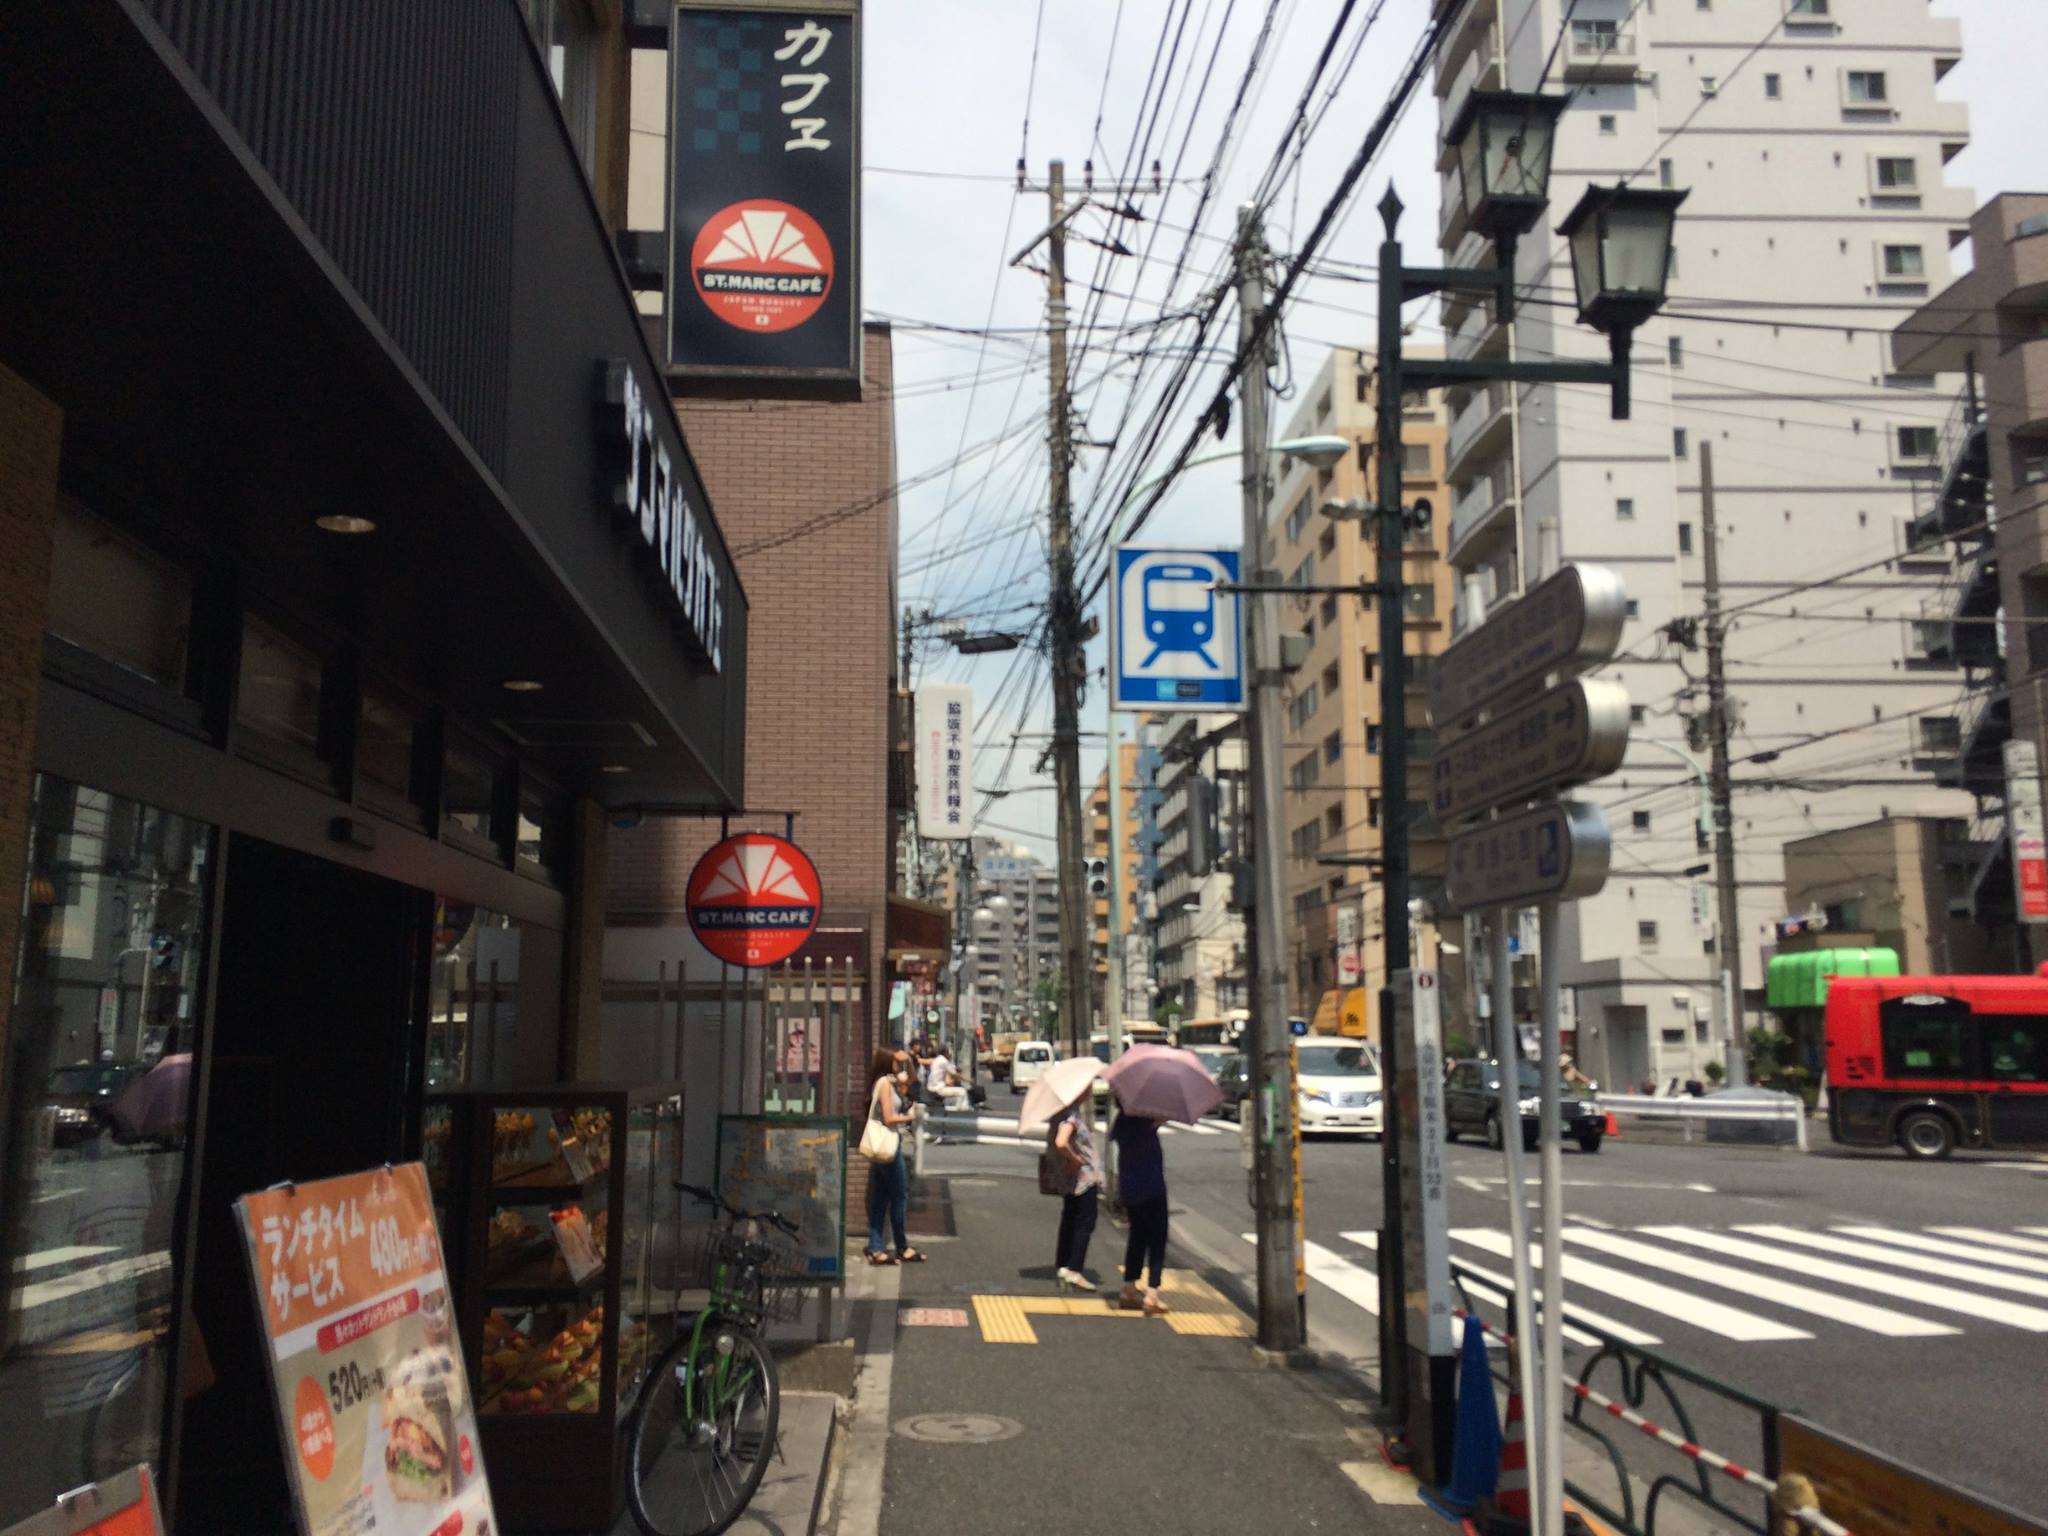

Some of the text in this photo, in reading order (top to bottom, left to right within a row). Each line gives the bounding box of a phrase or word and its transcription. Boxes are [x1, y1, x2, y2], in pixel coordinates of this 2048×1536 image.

[703, 274, 822, 293] ST.MARC CAFÉ
[624, 364, 722, 674] サンマルクカフェ
[698, 907, 810, 924] ST.MARC CAFÉ
[262, 1199, 365, 1266] ランチタイム
[271, 1256, 345, 1322] サービス
